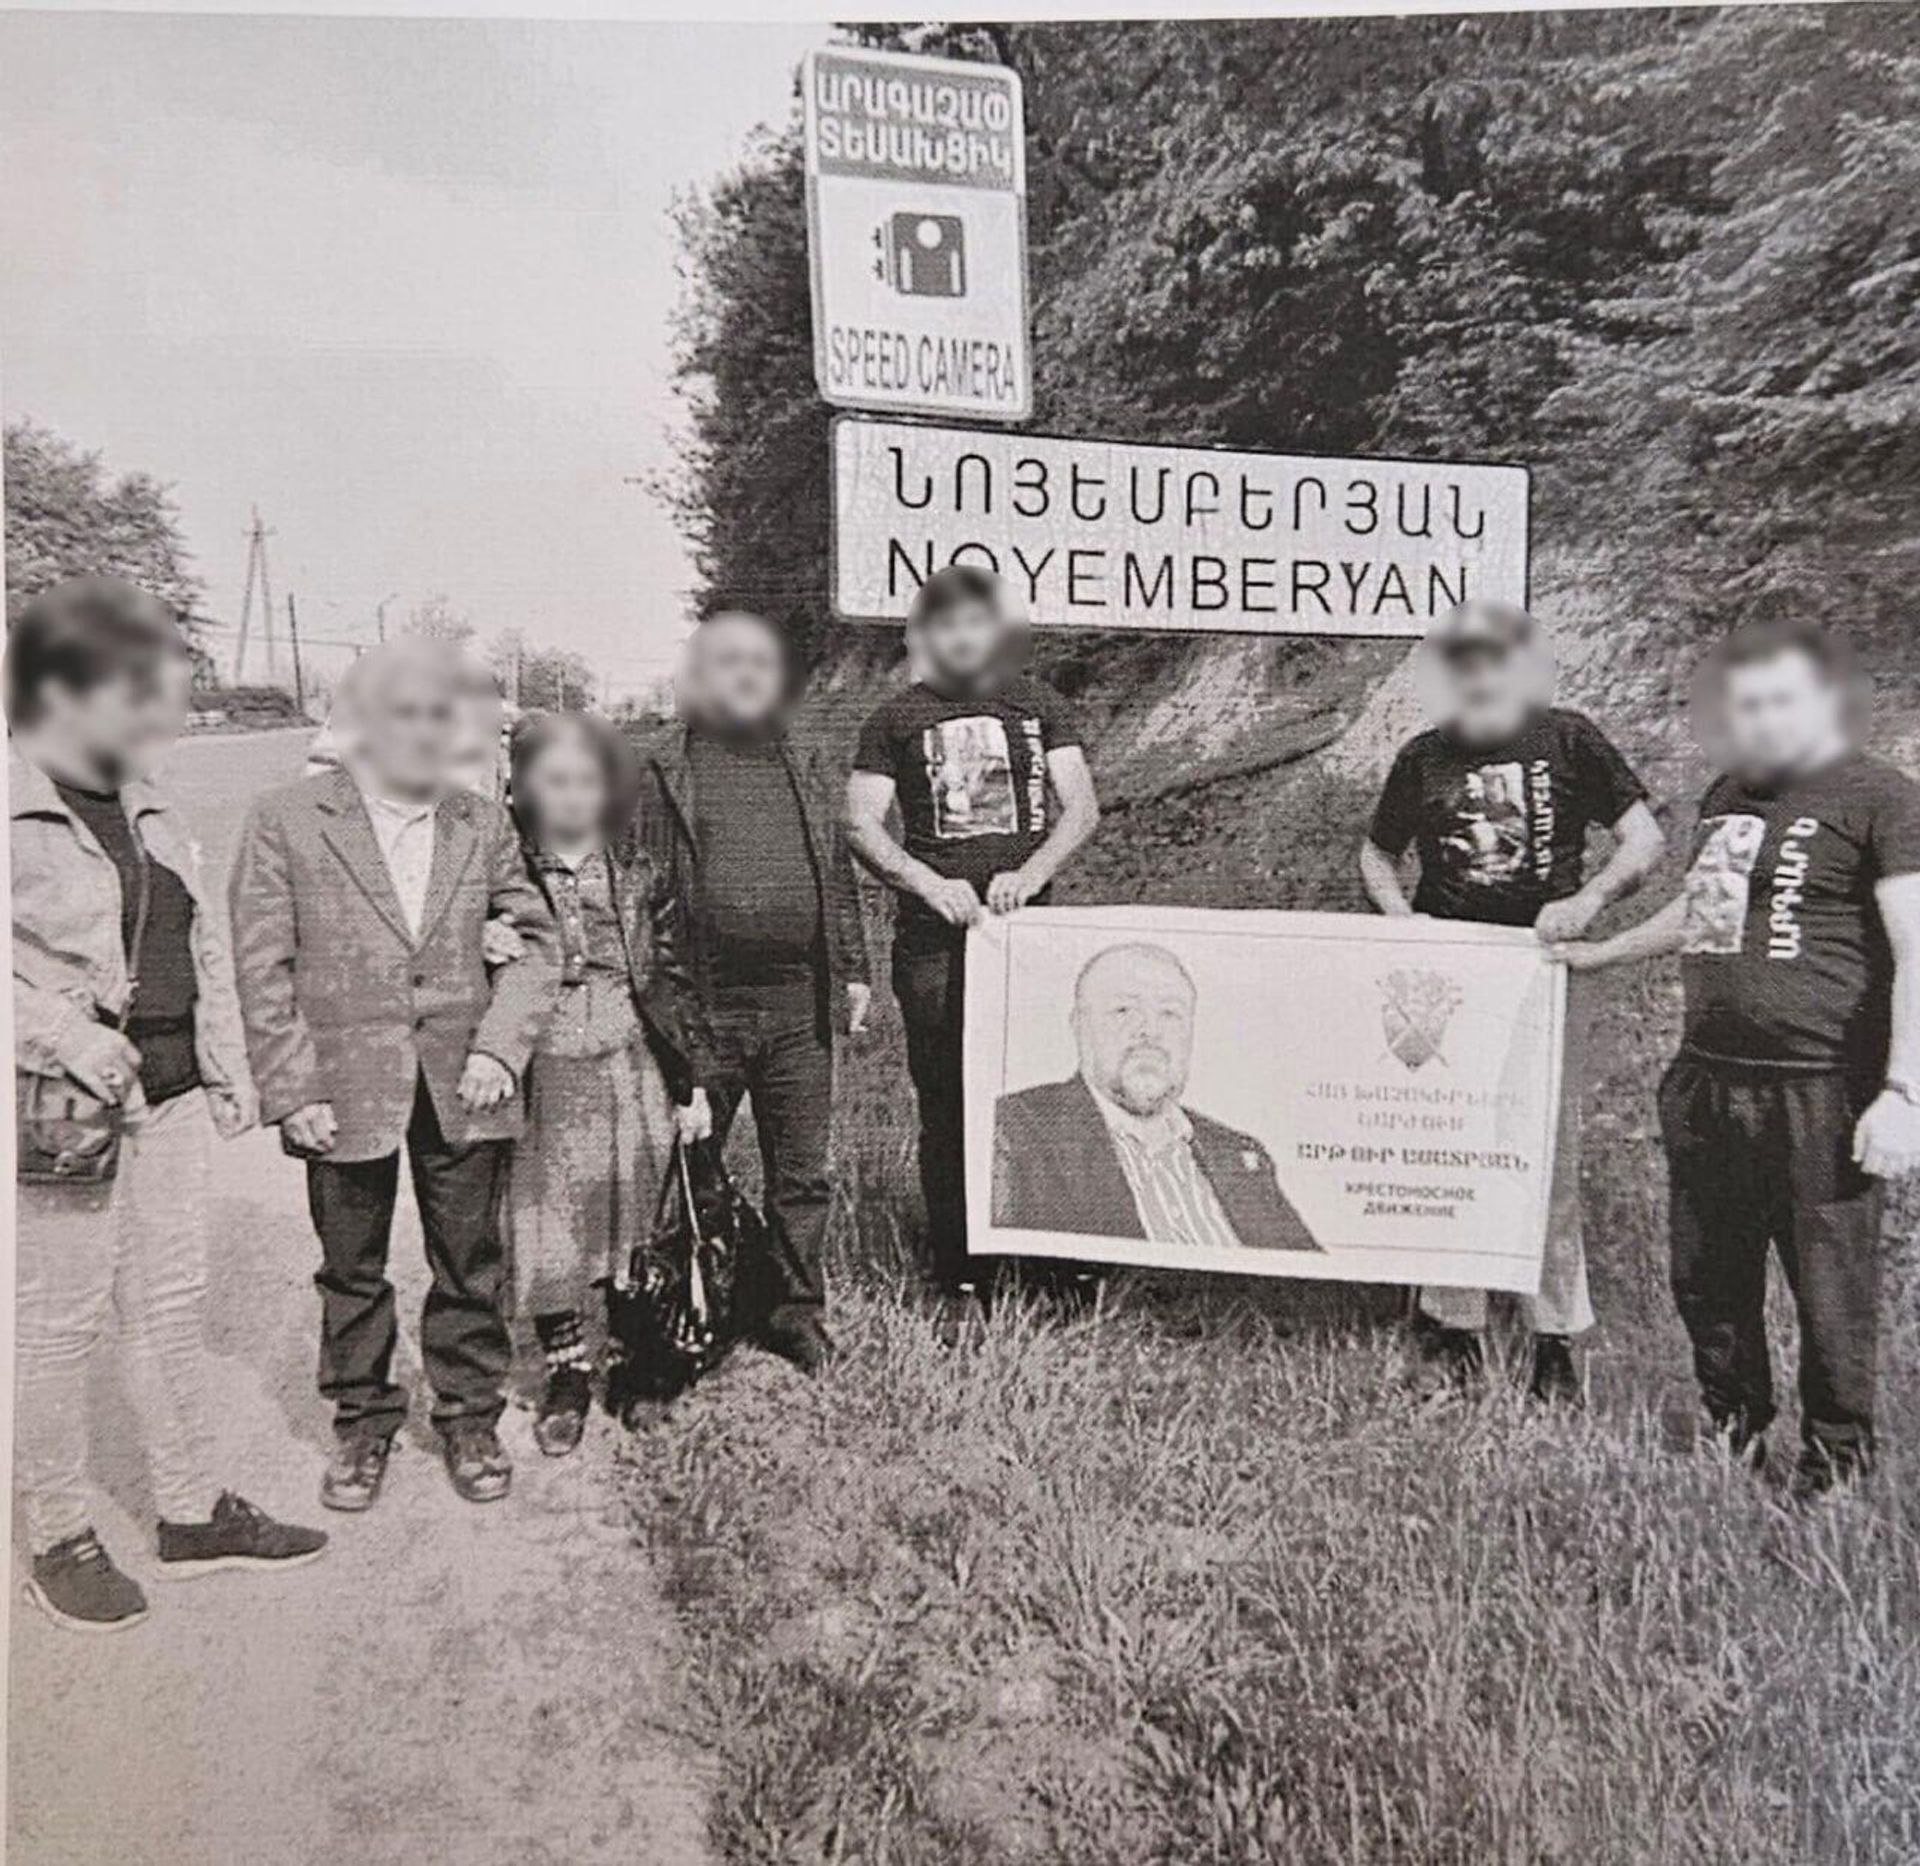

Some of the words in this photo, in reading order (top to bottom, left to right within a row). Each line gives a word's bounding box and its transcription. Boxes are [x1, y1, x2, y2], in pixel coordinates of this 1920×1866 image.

[817, 72, 1010, 132] ԱՐԱԳԱՉԱՓ
[819, 115, 1012, 177] ՏԵՍԱԽՑԻԿ
[830, 326, 910, 391] SPEED
[917, 334, 1018, 400] CAMERA
[888, 447, 1486, 540] ՆՈՅԵՄԲԵՐՅԱՆ
